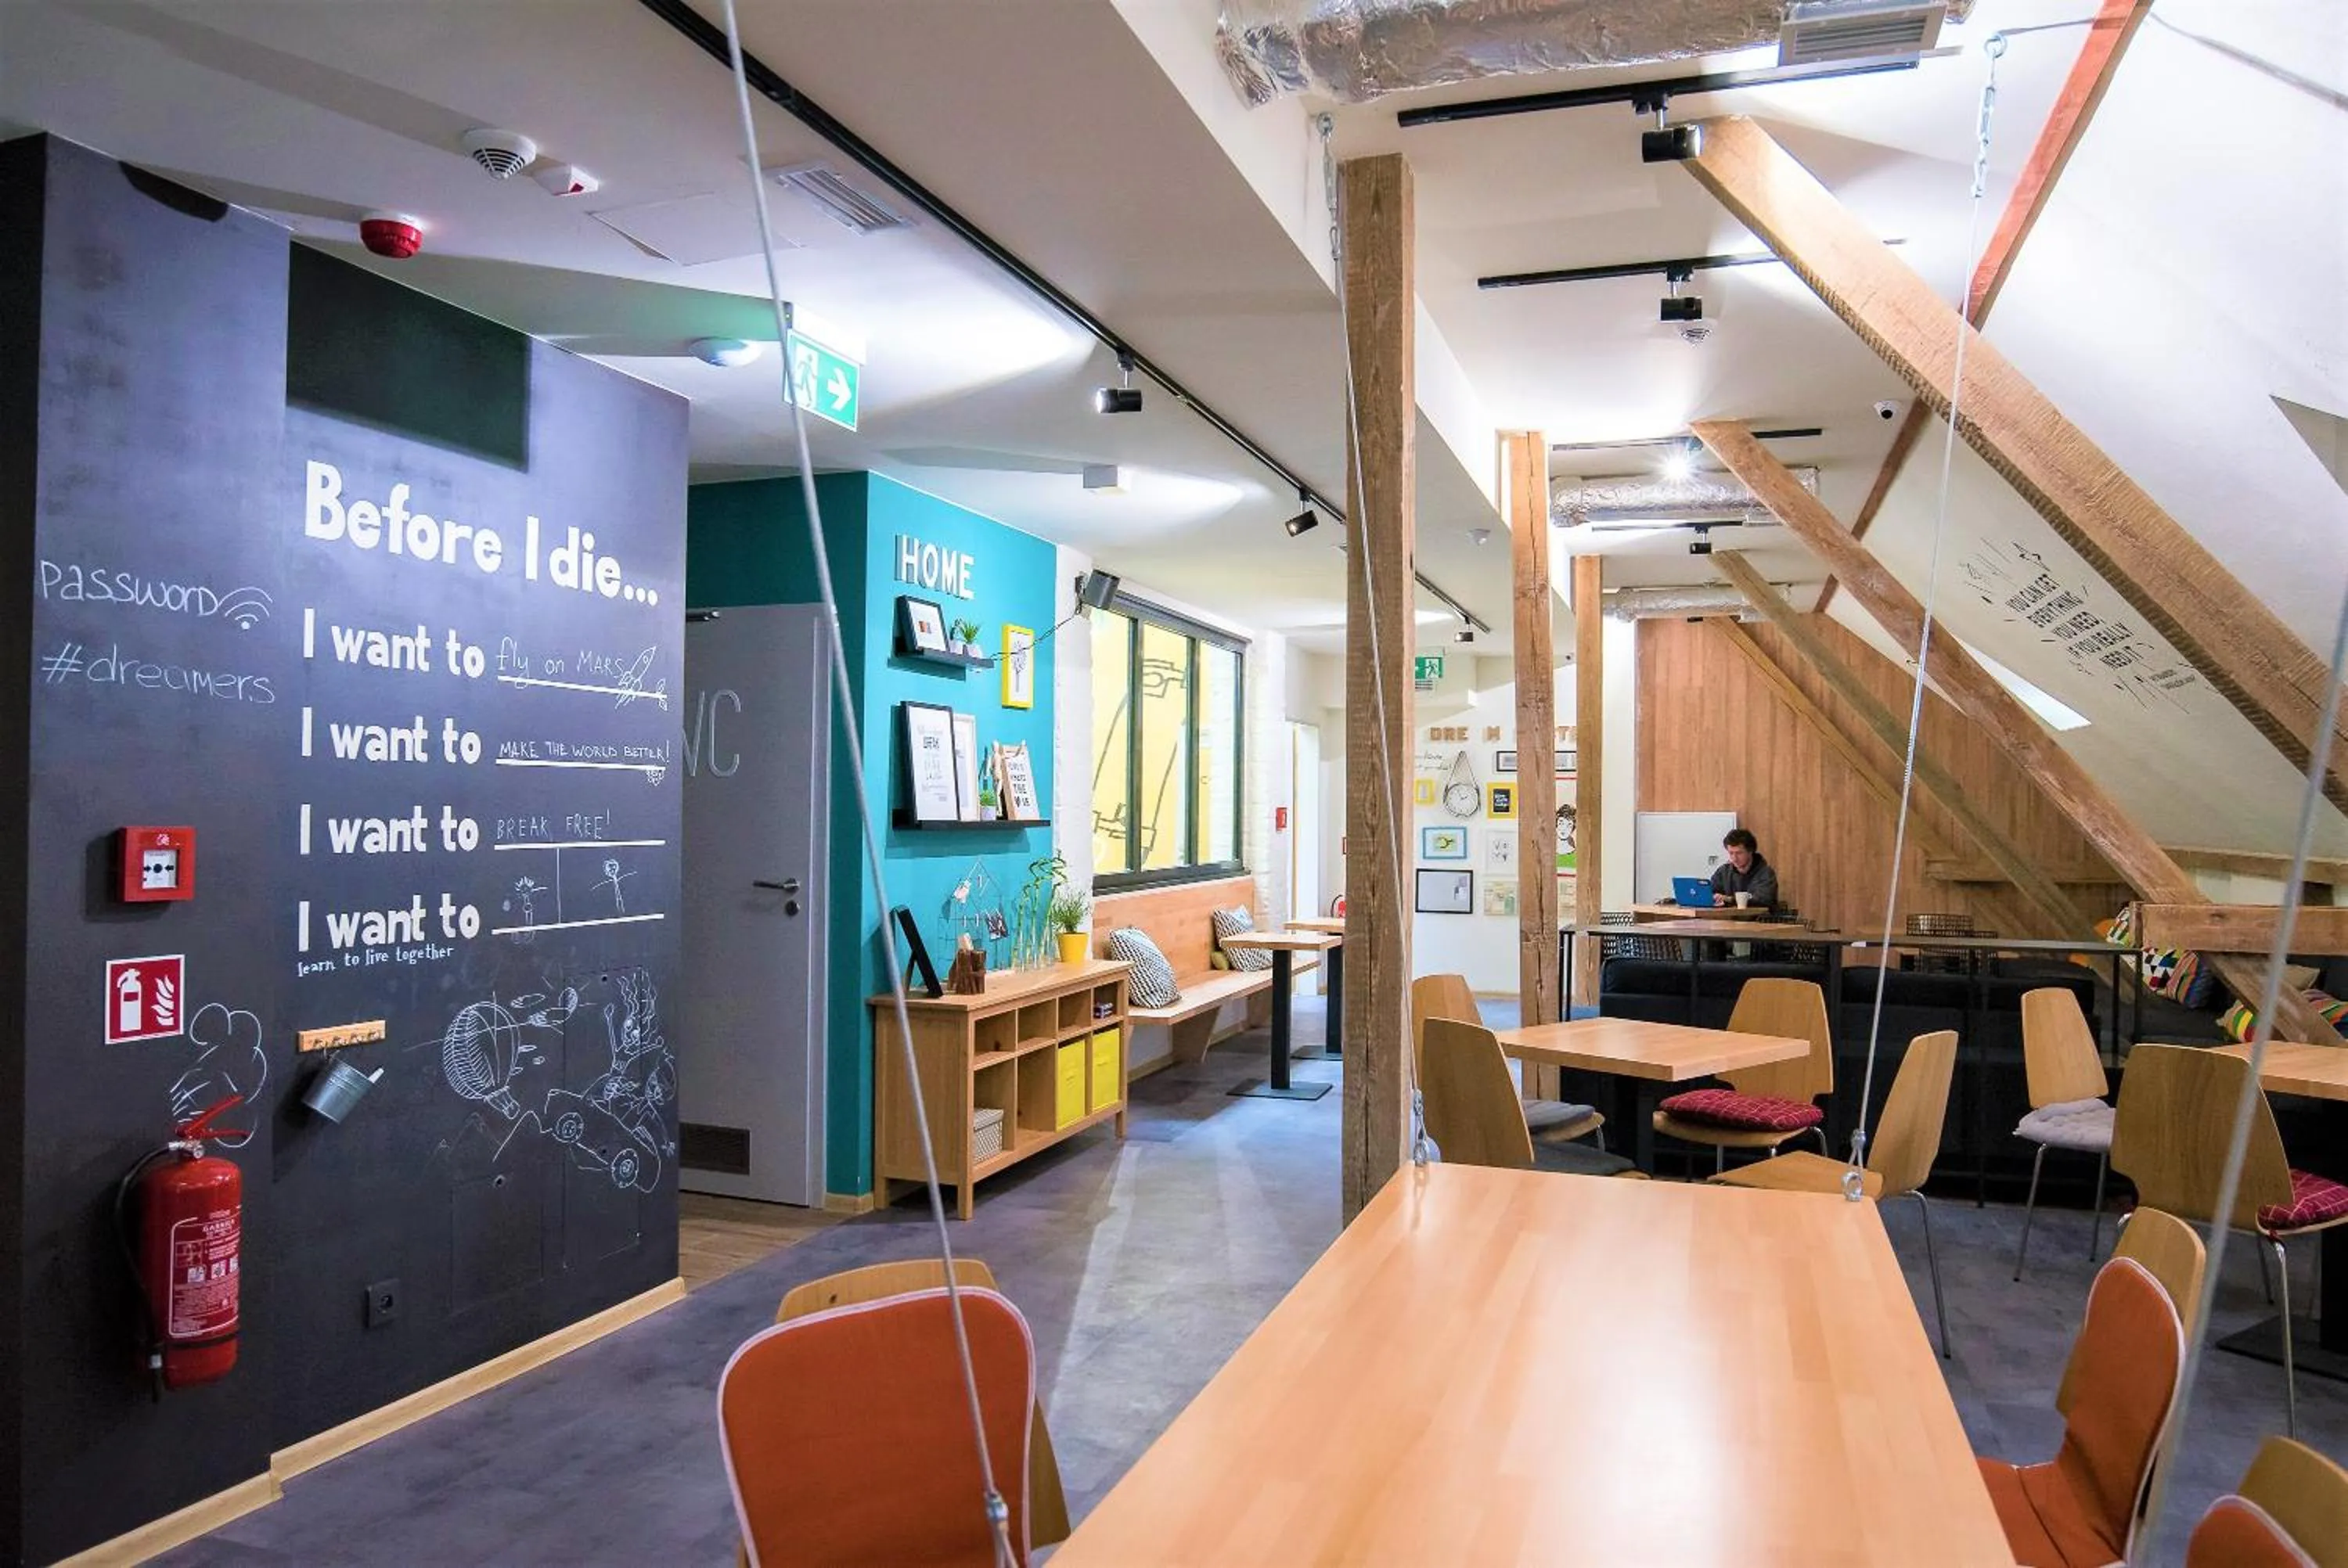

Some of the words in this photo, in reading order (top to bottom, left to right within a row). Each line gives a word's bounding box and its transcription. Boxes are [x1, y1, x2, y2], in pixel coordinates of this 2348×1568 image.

[304, 459, 503, 574] Before
[525, 515, 540, 581] I
[549, 525, 659, 606] die...
[900, 534, 975, 600] HOME
[303, 608, 315, 659] I
[331, 625, 431, 672] want
[445, 629, 485, 678] to
[496, 636, 530, 689] fly
[545, 658, 564, 675] on
[576, 650, 625, 679] MARS
[41, 642, 275, 704] #dreamers
[302, 707, 312, 757] I
[330, 716, 428, 762] want
[442, 717, 481, 764] to
[499, 741, 539, 758] MAKE
[546, 741, 568, 757] THE
[571, 746, 618, 757] WORLD
[300, 804, 311, 854] I
[328, 806, 428, 854] want
[441, 805, 480, 851] to
[497, 816, 549, 840] BREAK
[298, 901, 310, 951] I
[326, 895, 427, 949] want
[439, 893, 481, 940] to
[298, 960, 337, 977] learn
[344, 952, 360, 966] to
[365, 949, 389, 966] live
[396, 943, 455, 965] together
